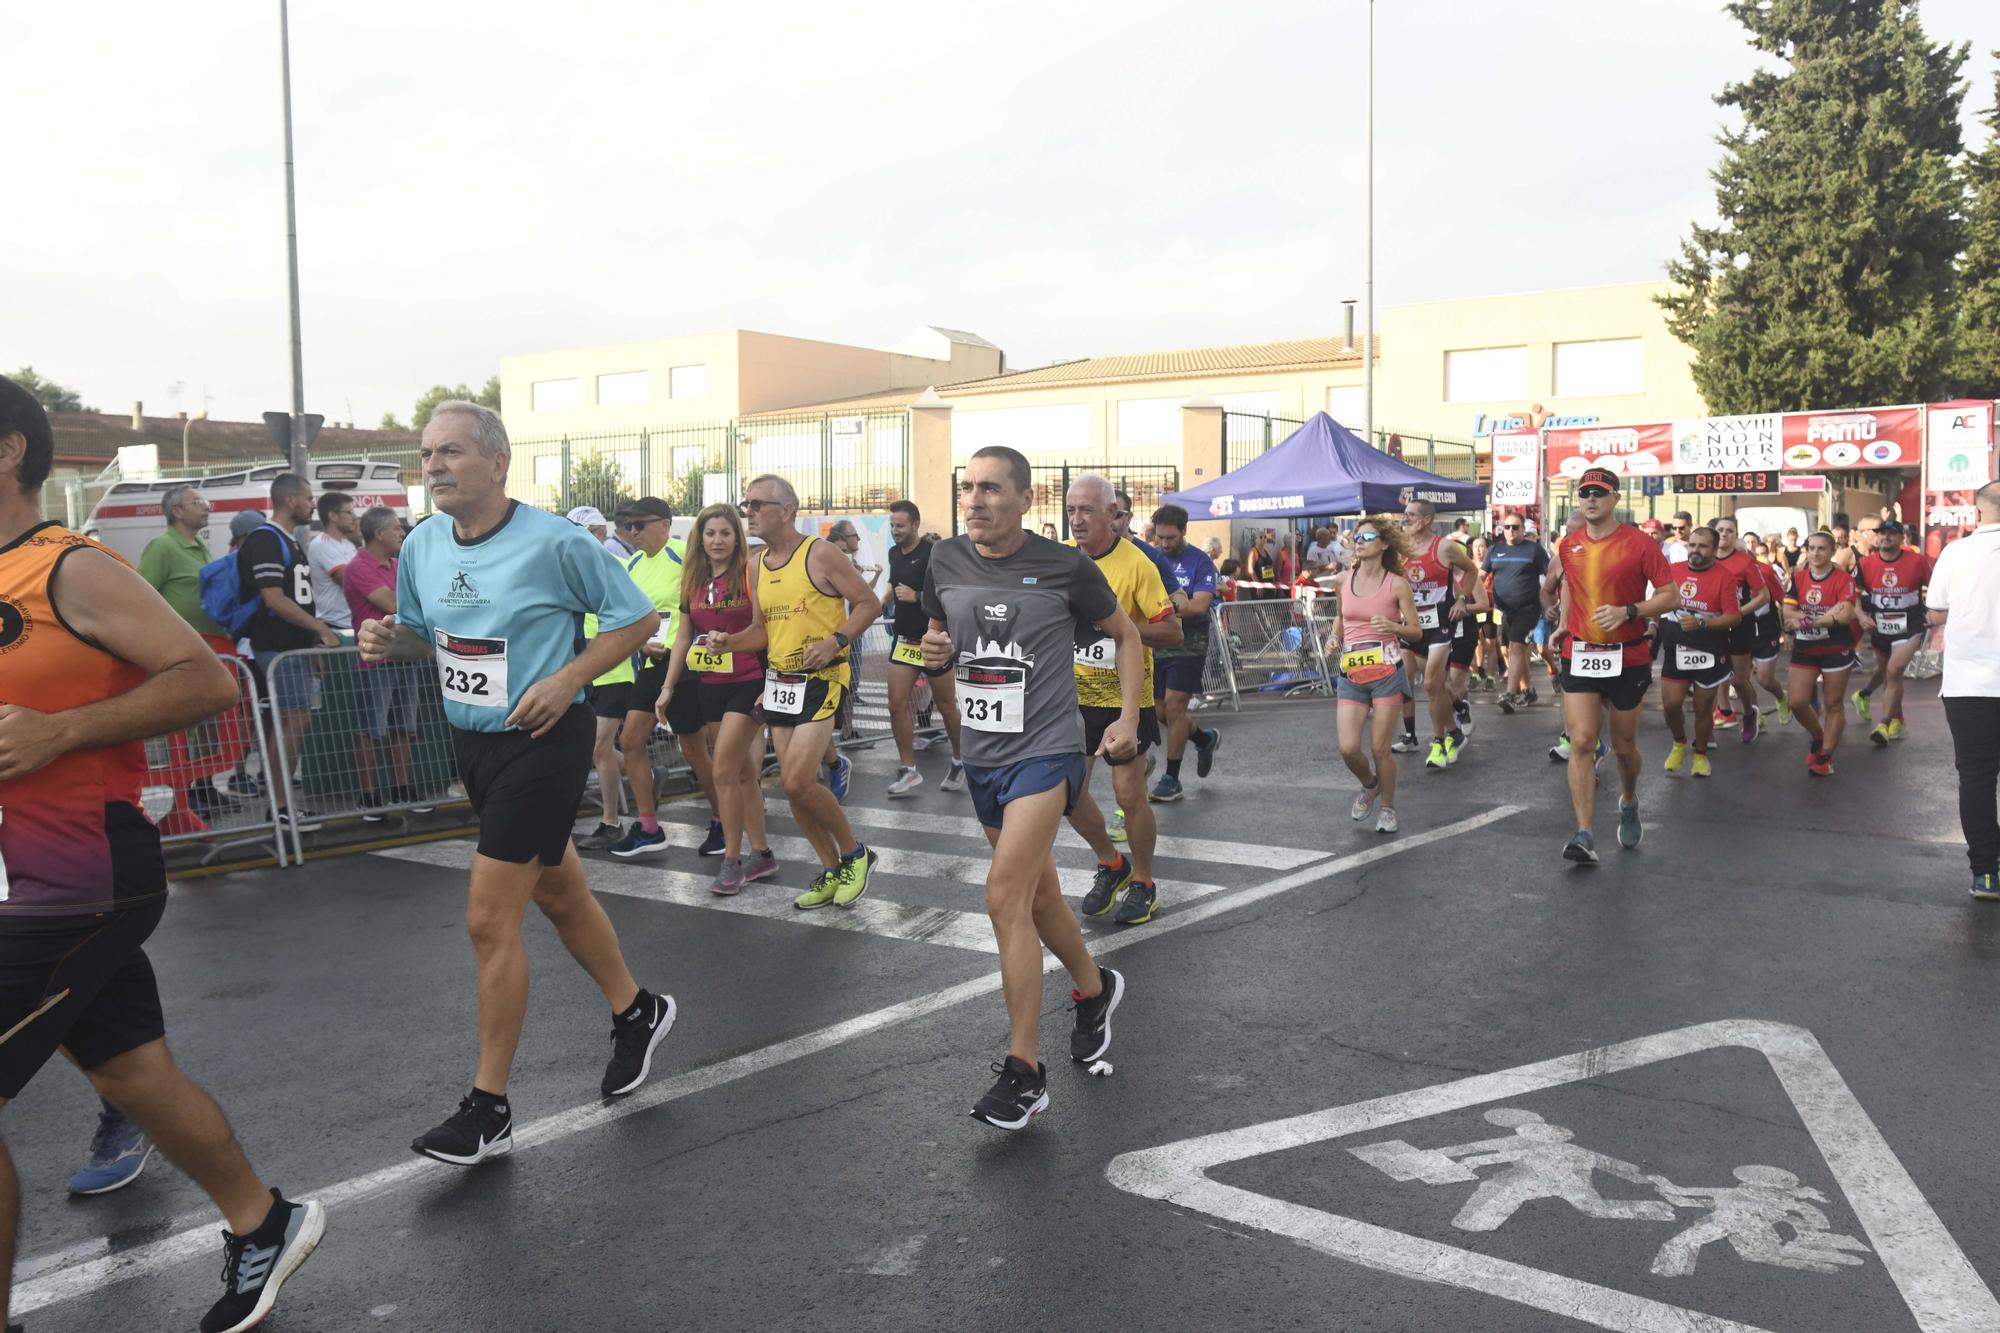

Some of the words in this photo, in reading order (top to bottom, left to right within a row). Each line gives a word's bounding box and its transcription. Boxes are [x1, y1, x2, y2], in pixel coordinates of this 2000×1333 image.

[1707, 418, 1773, 433] XXVIII
[1707, 432, 1773, 445] NON
[1708, 444, 1773, 457] DUER
[1708, 456, 1774, 468] MAS
[1695, 473, 1767, 490] 0:00:53
[1239, 495, 1305, 512] DORSAL21.COM
[1881, 622, 1900, 631] 298
[694, 652, 723, 665] 763
[902, 648, 922, 660] 789
[1684, 655, 1707, 665] 200
[1348, 655, 1375, 667] 815
[1581, 658, 1612, 671] 289
[445, 666, 489, 695] 232
[772, 689, 796, 705] 138
[965, 696, 1003, 722] 231
